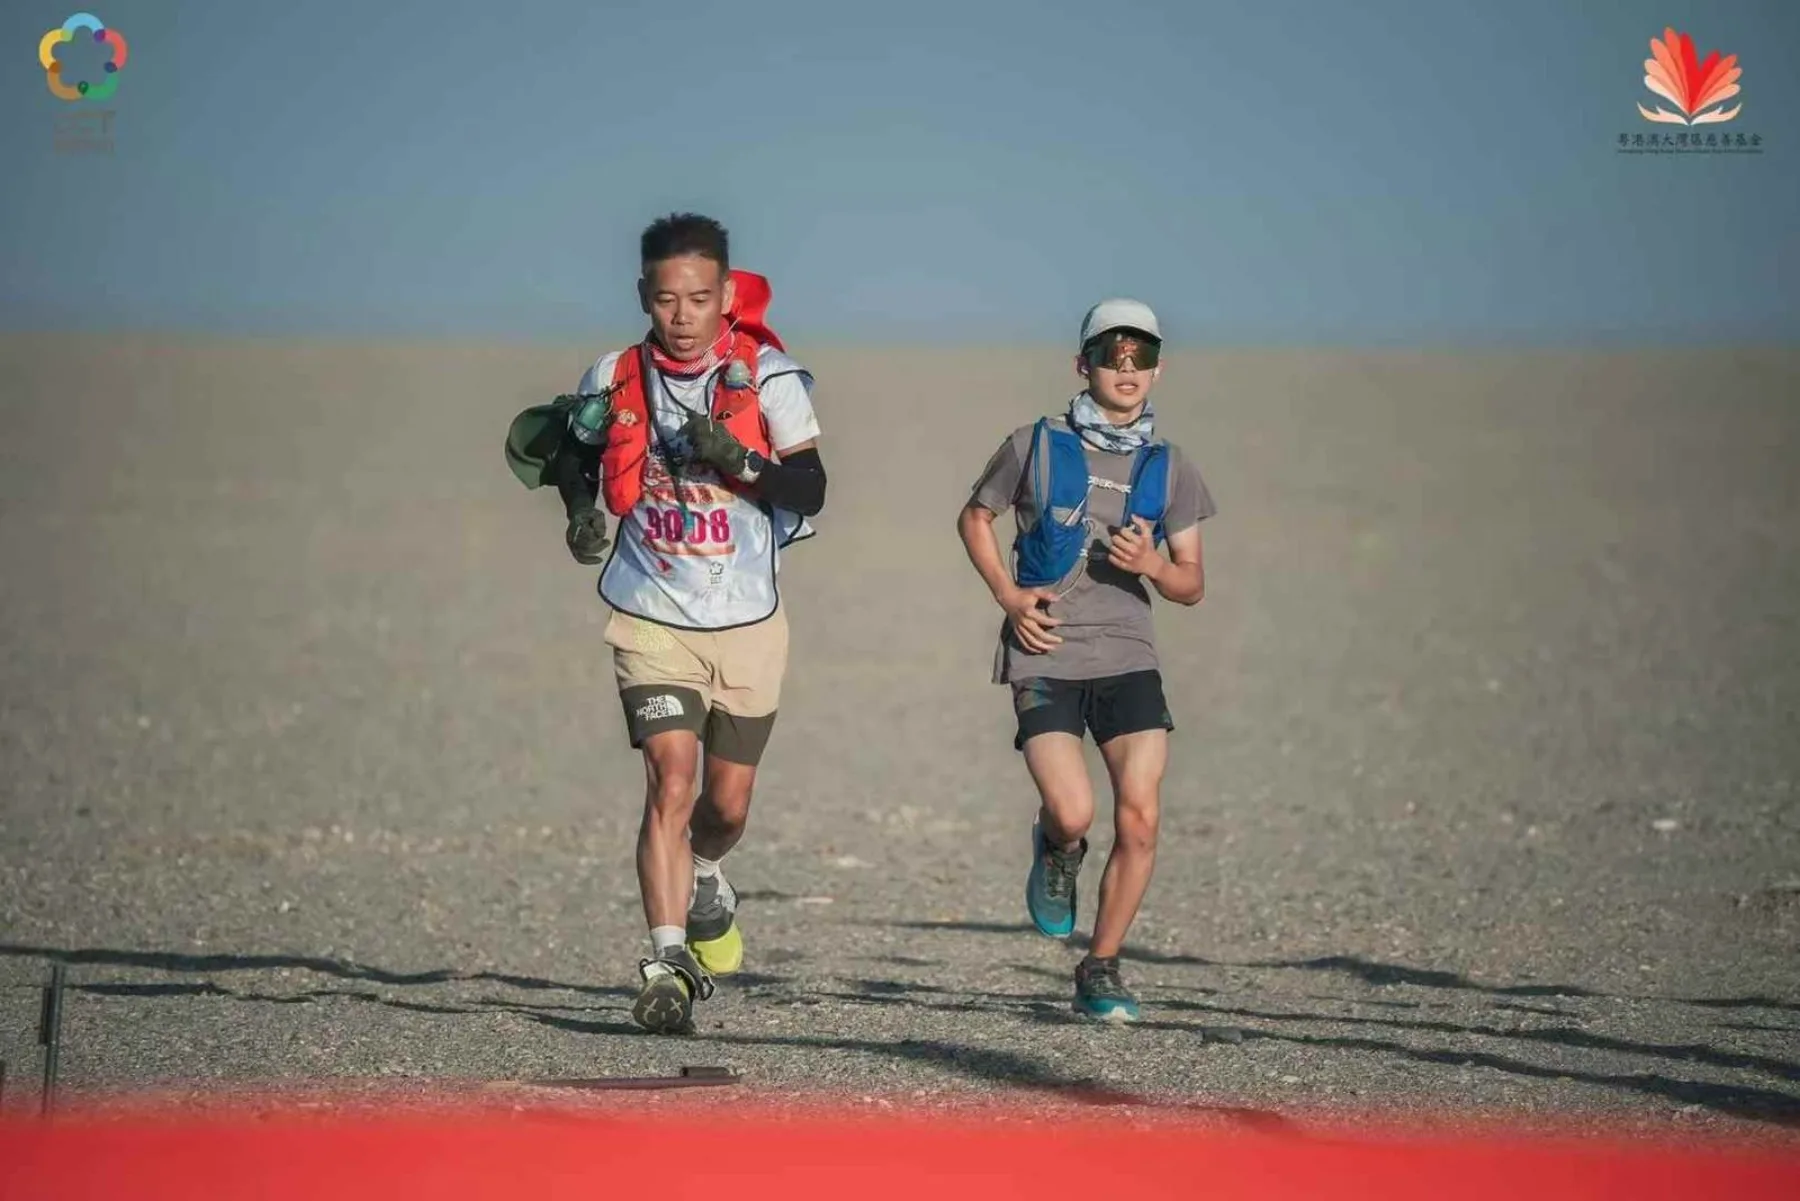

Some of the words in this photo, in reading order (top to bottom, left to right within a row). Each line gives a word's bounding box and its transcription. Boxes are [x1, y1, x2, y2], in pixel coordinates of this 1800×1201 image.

[646, 695, 666, 706] THE
[635, 702, 667, 718] NORTH
[645, 710, 669, 721] FACE
